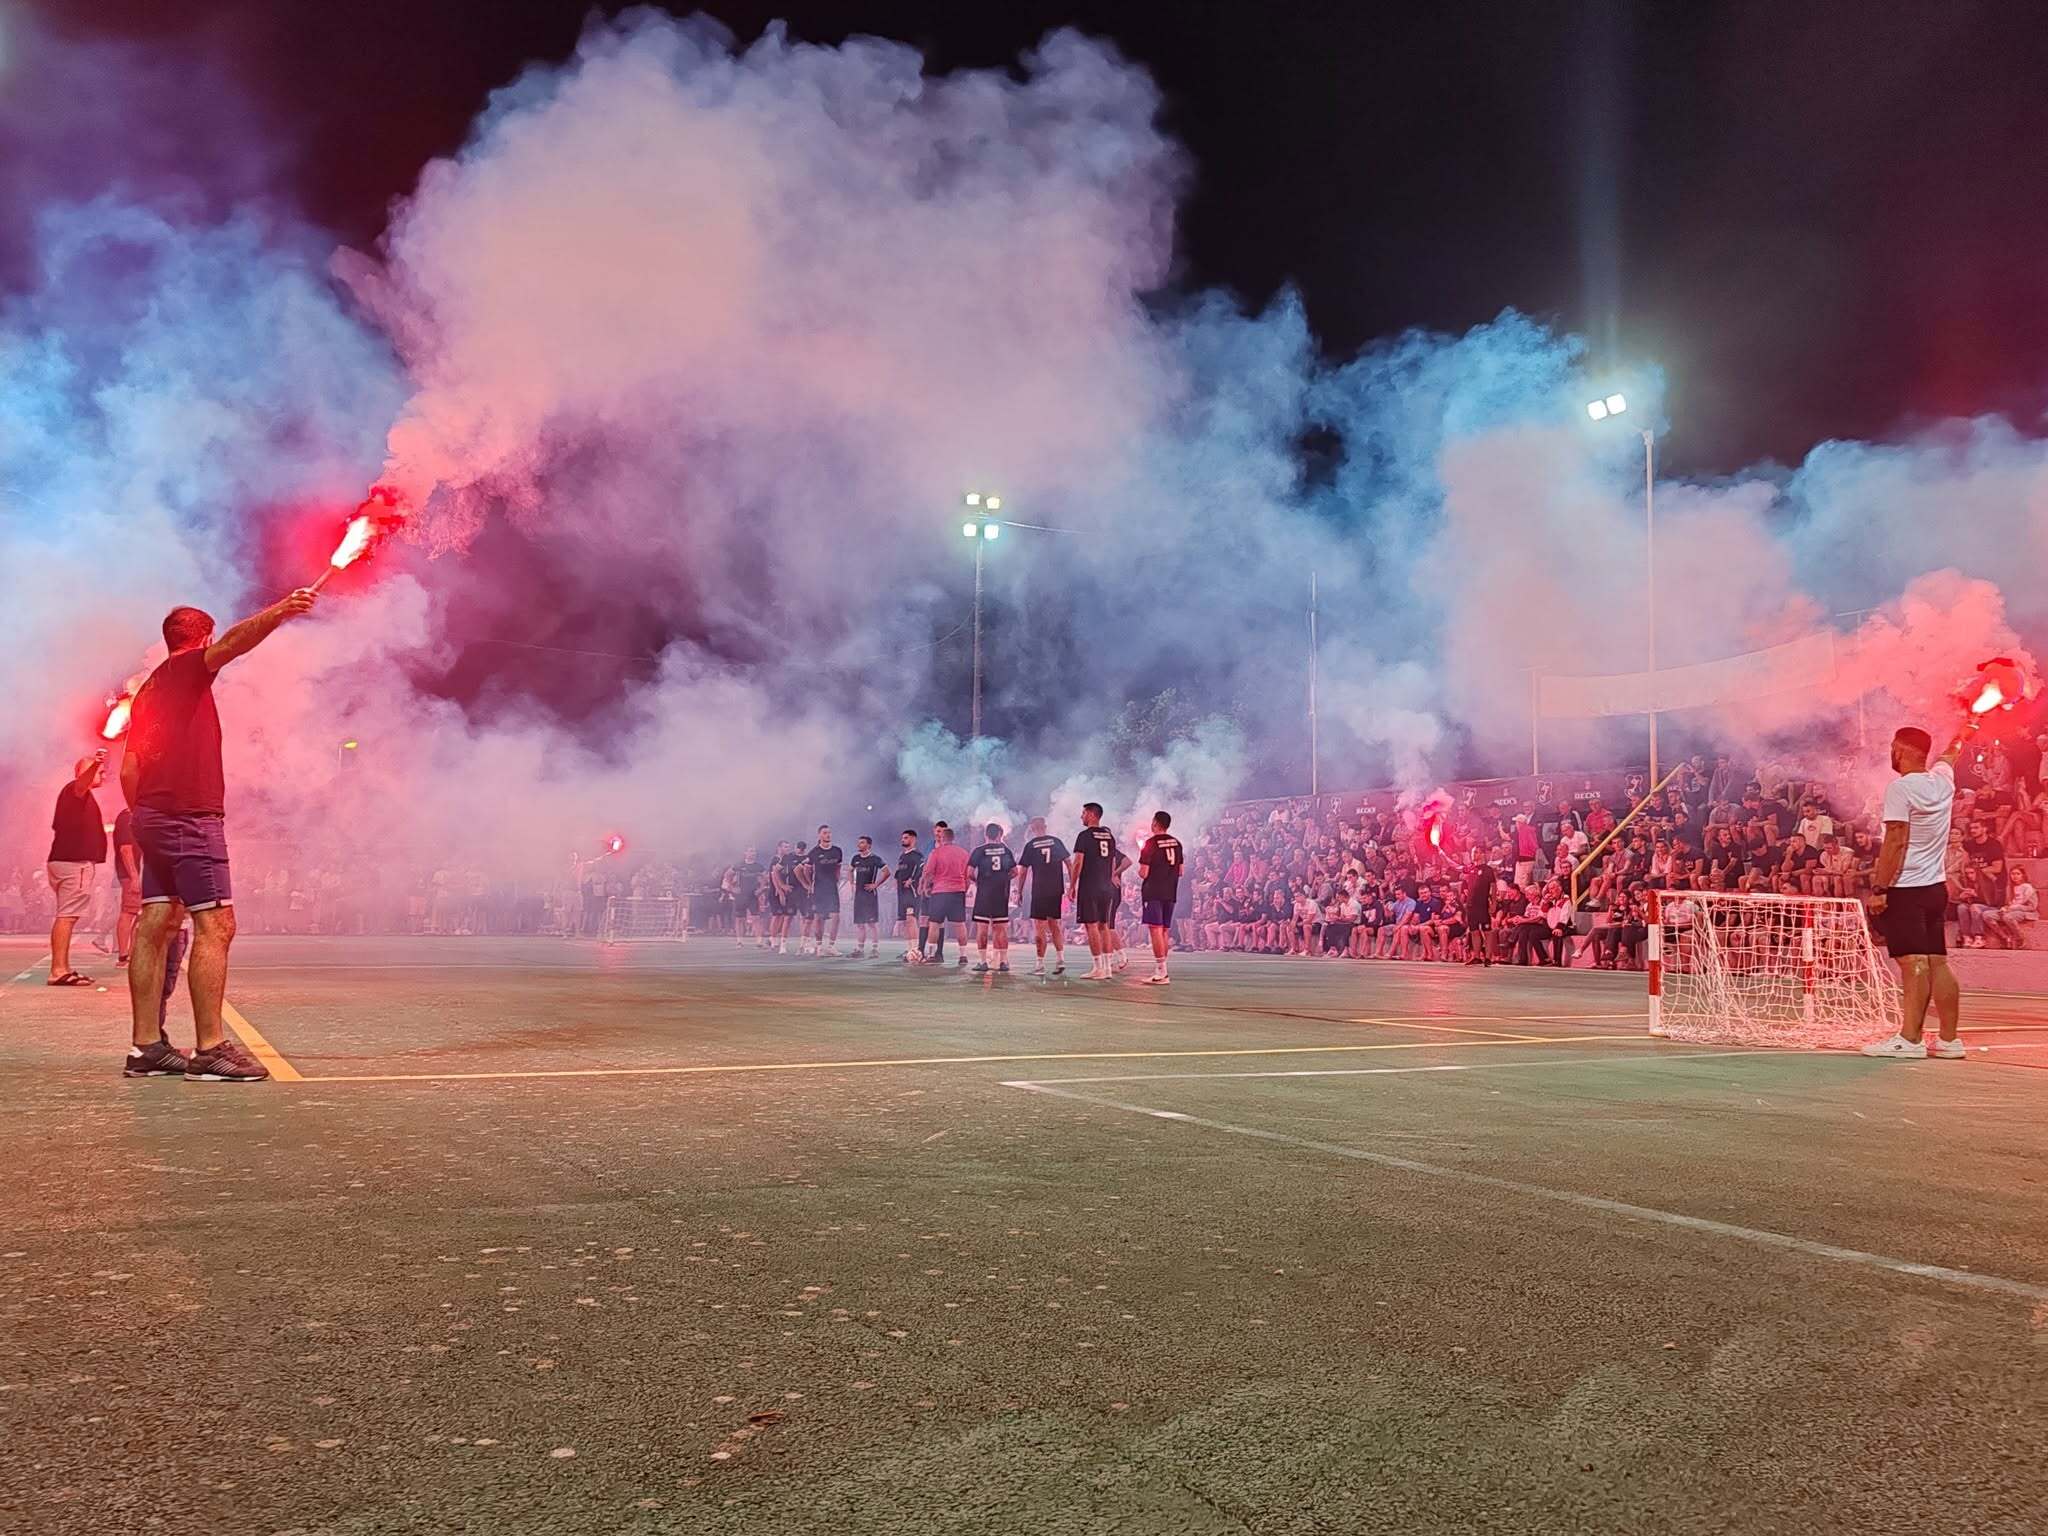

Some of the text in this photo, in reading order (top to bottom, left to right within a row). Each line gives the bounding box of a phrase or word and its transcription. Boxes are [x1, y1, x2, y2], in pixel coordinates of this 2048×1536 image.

[992, 855, 1001, 870] 3
[1041, 847, 1050, 863] 7
[1166, 847, 1175, 865] 4
